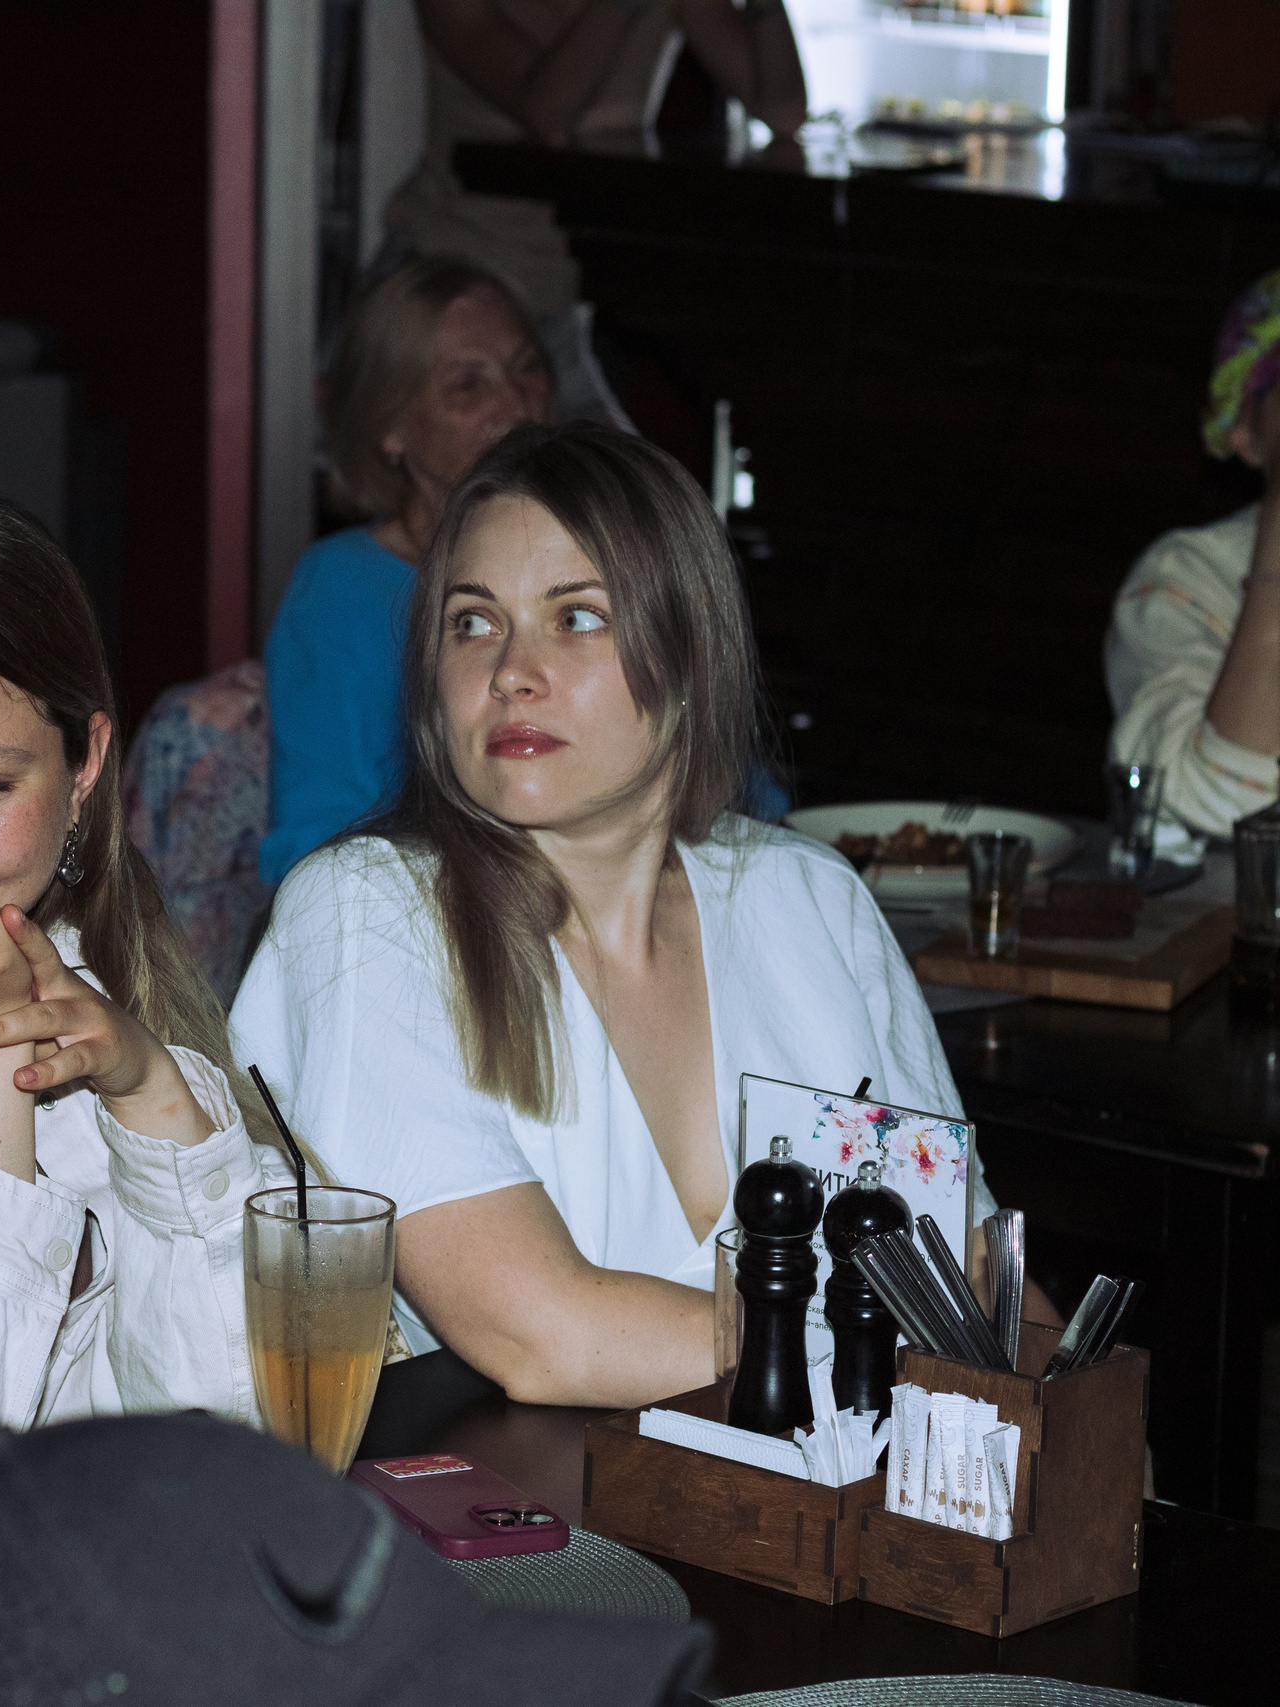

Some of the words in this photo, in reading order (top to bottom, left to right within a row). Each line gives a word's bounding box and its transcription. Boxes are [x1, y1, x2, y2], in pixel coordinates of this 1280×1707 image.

[902, 1448, 911, 1482] САХАР
[957, 1454, 966, 1489] SUGAR
[974, 1456, 984, 1492] SUGAR
[999, 1461, 1011, 1496] SUGAR
